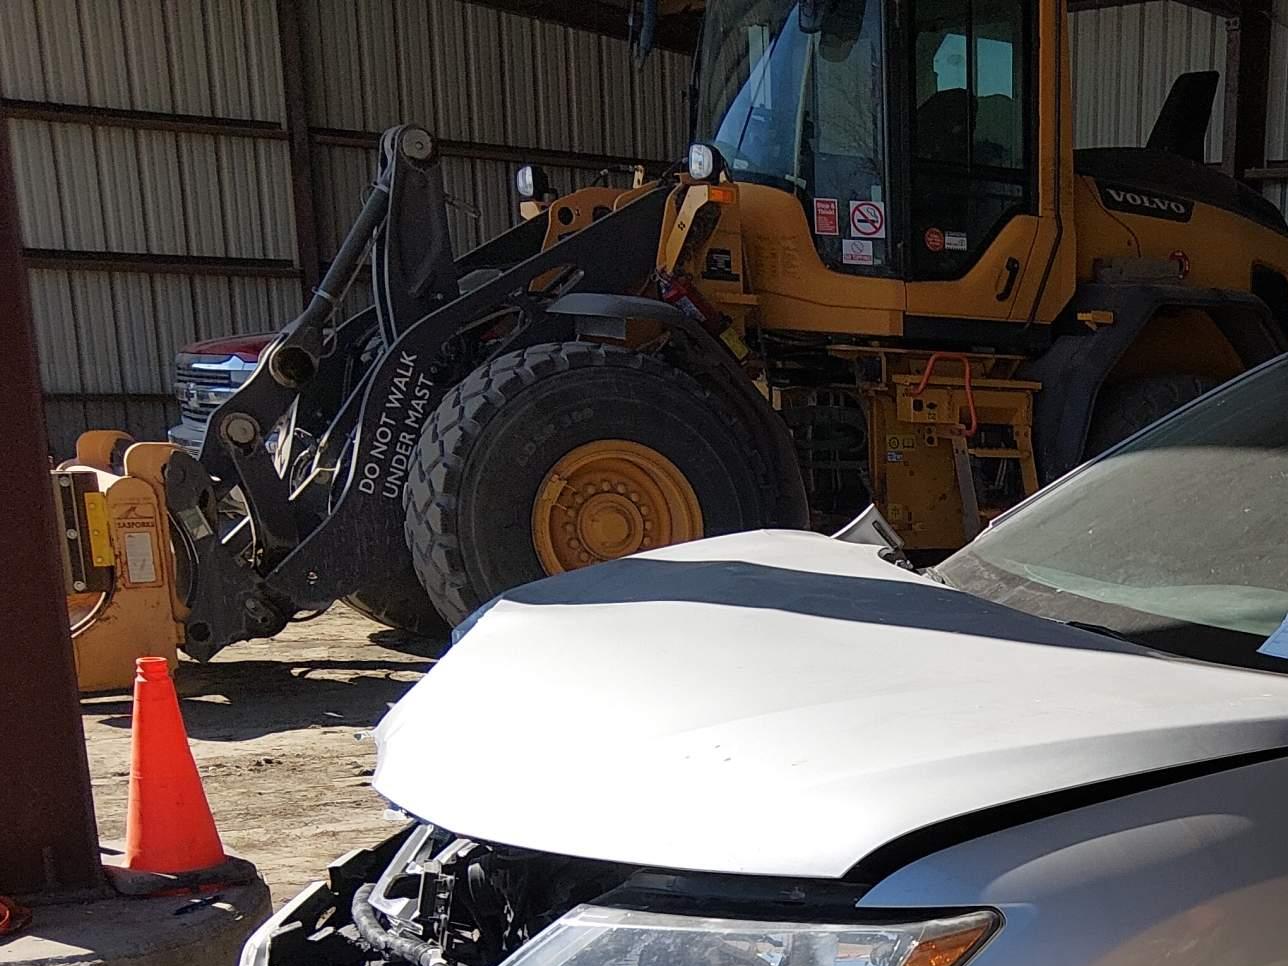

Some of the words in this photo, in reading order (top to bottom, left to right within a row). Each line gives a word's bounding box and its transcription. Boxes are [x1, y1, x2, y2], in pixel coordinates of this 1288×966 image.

[1105, 188, 1185, 214] VOLVO
[359, 463, 380, 494] DO
[370, 412, 397, 459] NOT
[385, 350, 418, 408] WALK
[382, 431, 416, 498] UNDER
[405, 373, 435, 428] MAST
